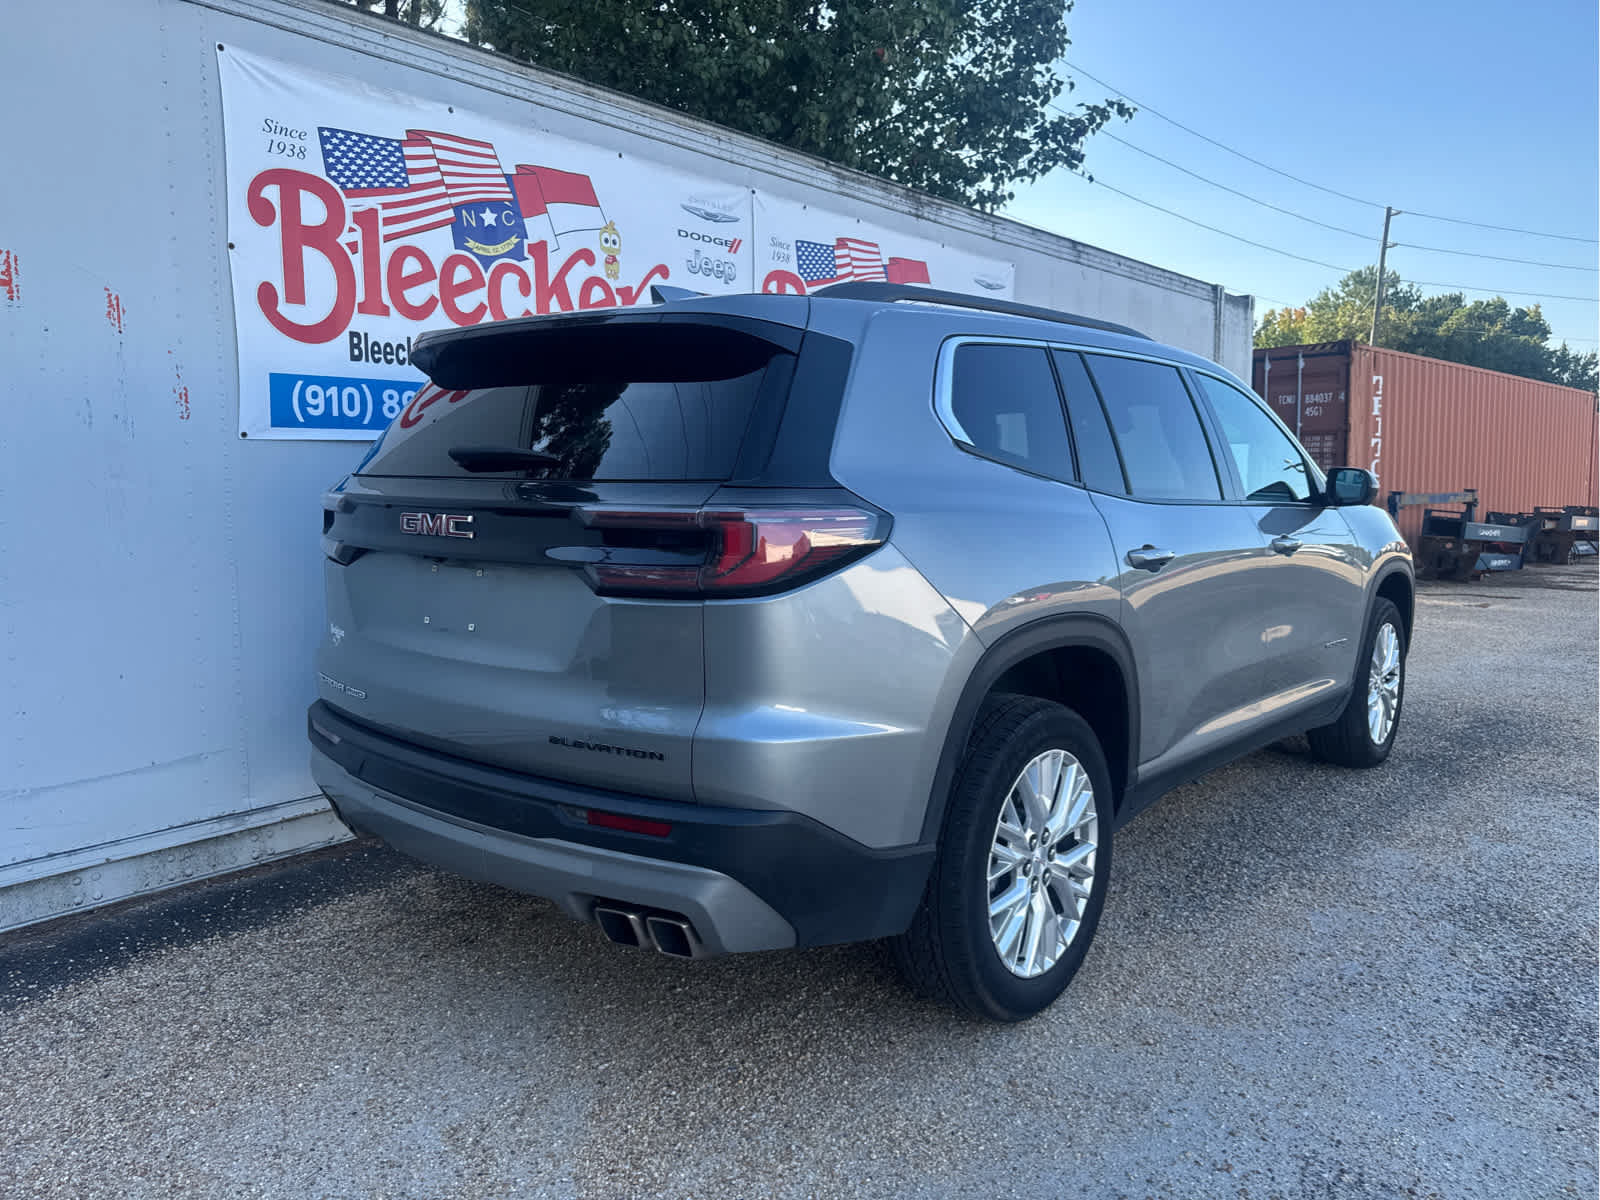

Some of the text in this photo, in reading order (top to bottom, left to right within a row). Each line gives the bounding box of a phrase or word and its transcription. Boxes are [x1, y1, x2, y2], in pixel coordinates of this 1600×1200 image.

[262, 118, 307, 141] Since
[267, 139, 307, 160] 1938
[462, 208, 516, 227] N C
[678, 229, 733, 248] DODGE
[770, 236, 791, 250] Since
[687, 249, 736, 285] Jeep
[292, 380, 373, 424] (910)
[400, 512, 474, 539] GMC
[548, 735, 665, 762] ELEVATION
